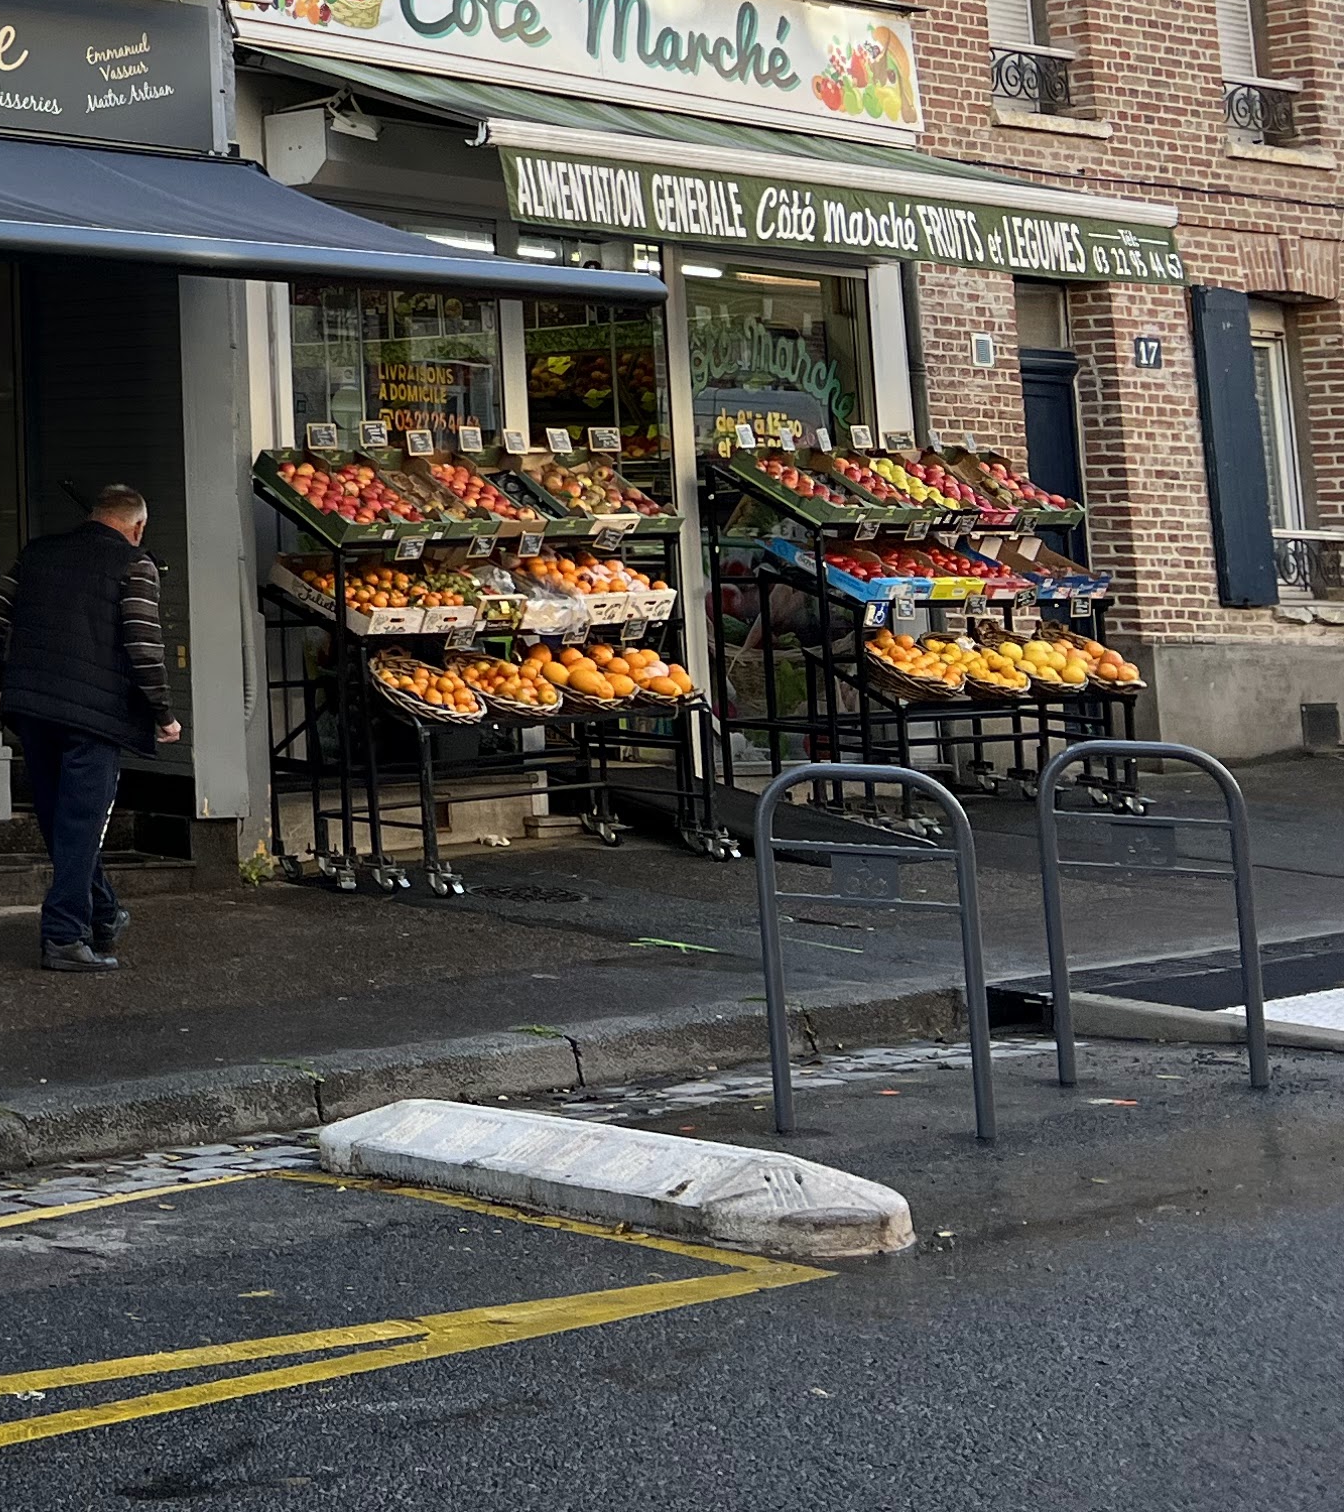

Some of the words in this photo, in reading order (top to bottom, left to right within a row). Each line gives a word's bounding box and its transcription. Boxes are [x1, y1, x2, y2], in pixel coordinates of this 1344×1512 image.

[85, 33, 151, 66] Emmanuel
[99, 60, 150, 82] Vasseur
[128, 84, 175, 107] Artisan
[515, 156, 647, 230] ALIMENTATION
[651, 172, 744, 240] GENERALE
[755, 187, 816, 243] Côté
[823, 198, 919, 253] Marché
[917, 205, 984, 264] FRUITS
[988, 230, 1005, 266] et
[1002, 215, 1086, 275] LEGUMES
[1092, 245, 1110, 275] 03
[1110, 247, 1132, 276] 22
[1149, 251, 1168, 279] 44
[1139, 341, 1159, 365] 17
[378, 361, 454, 385] LIVRAISONS
[389, 383, 448, 404] DOMICILE
